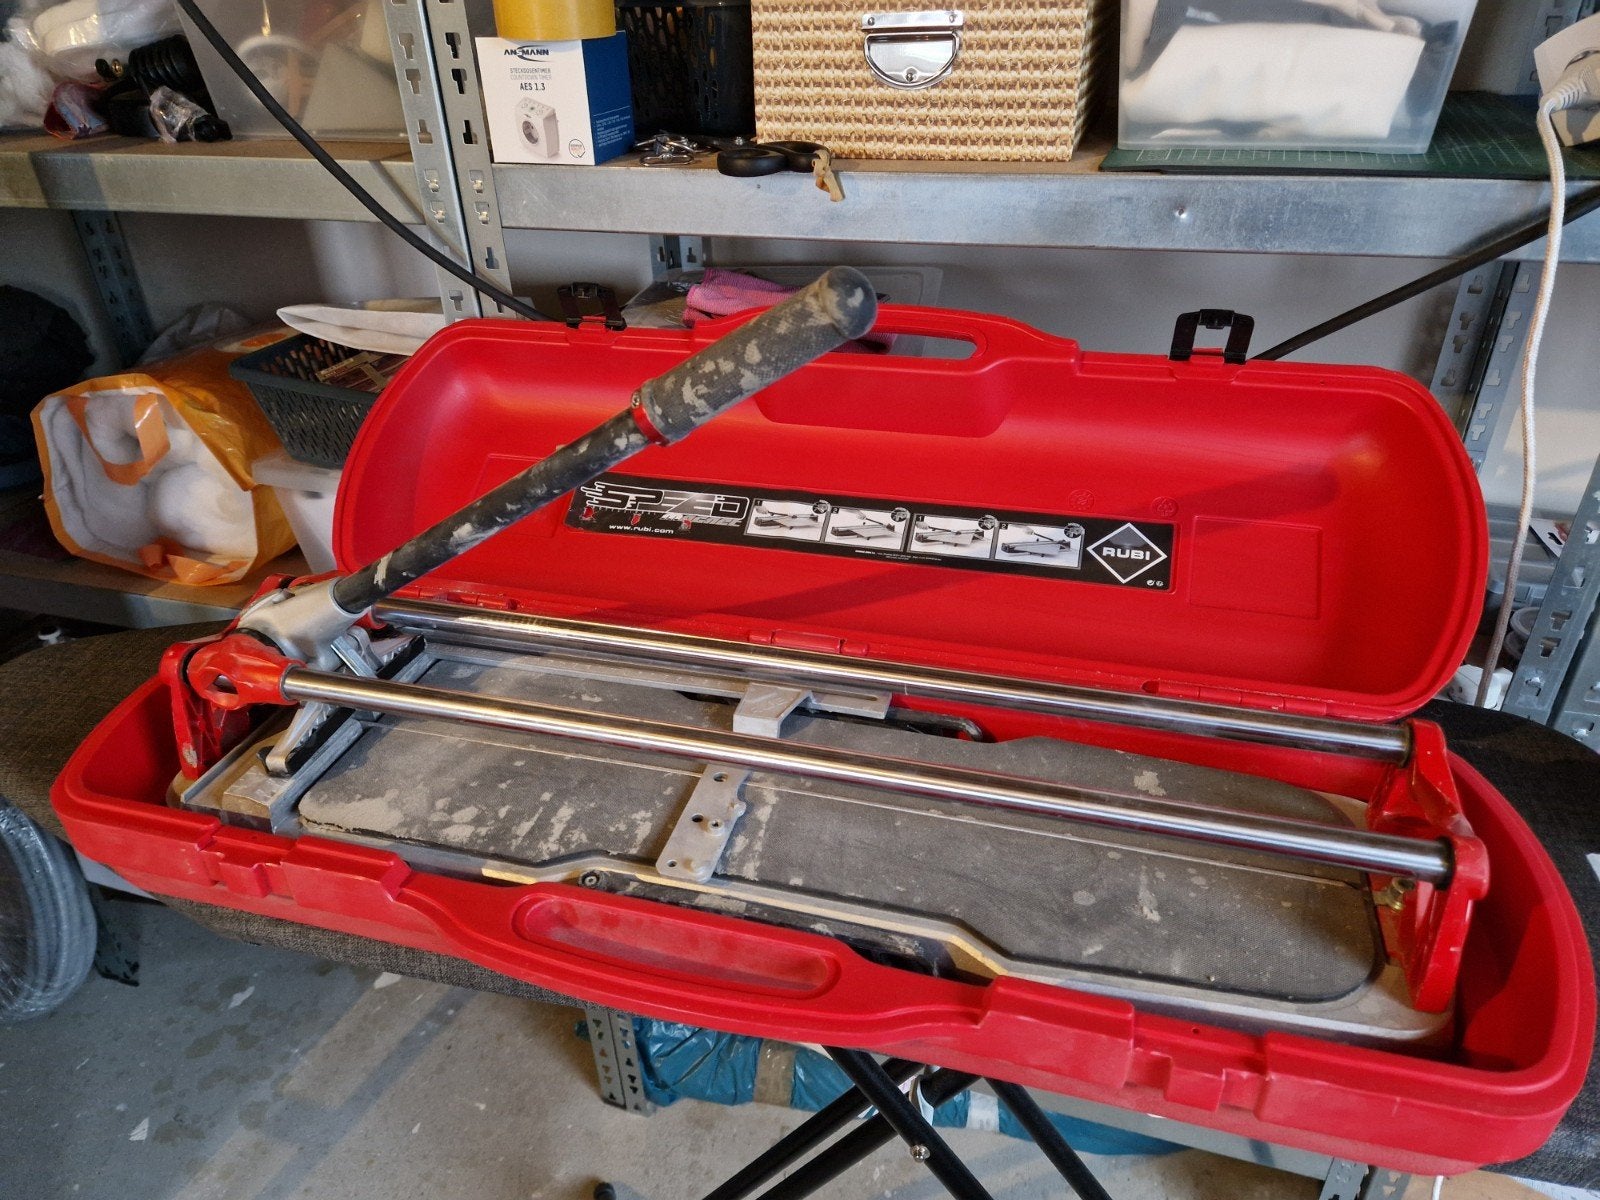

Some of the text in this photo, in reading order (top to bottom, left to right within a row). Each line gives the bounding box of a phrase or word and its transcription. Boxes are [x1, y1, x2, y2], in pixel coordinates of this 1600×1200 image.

[520, 82, 546, 91] AES 1.3
[580, 481, 750, 519] SPEED
[608, 524, 674, 534] www.rubi.com
[1102, 546, 1151, 560] RUBI
